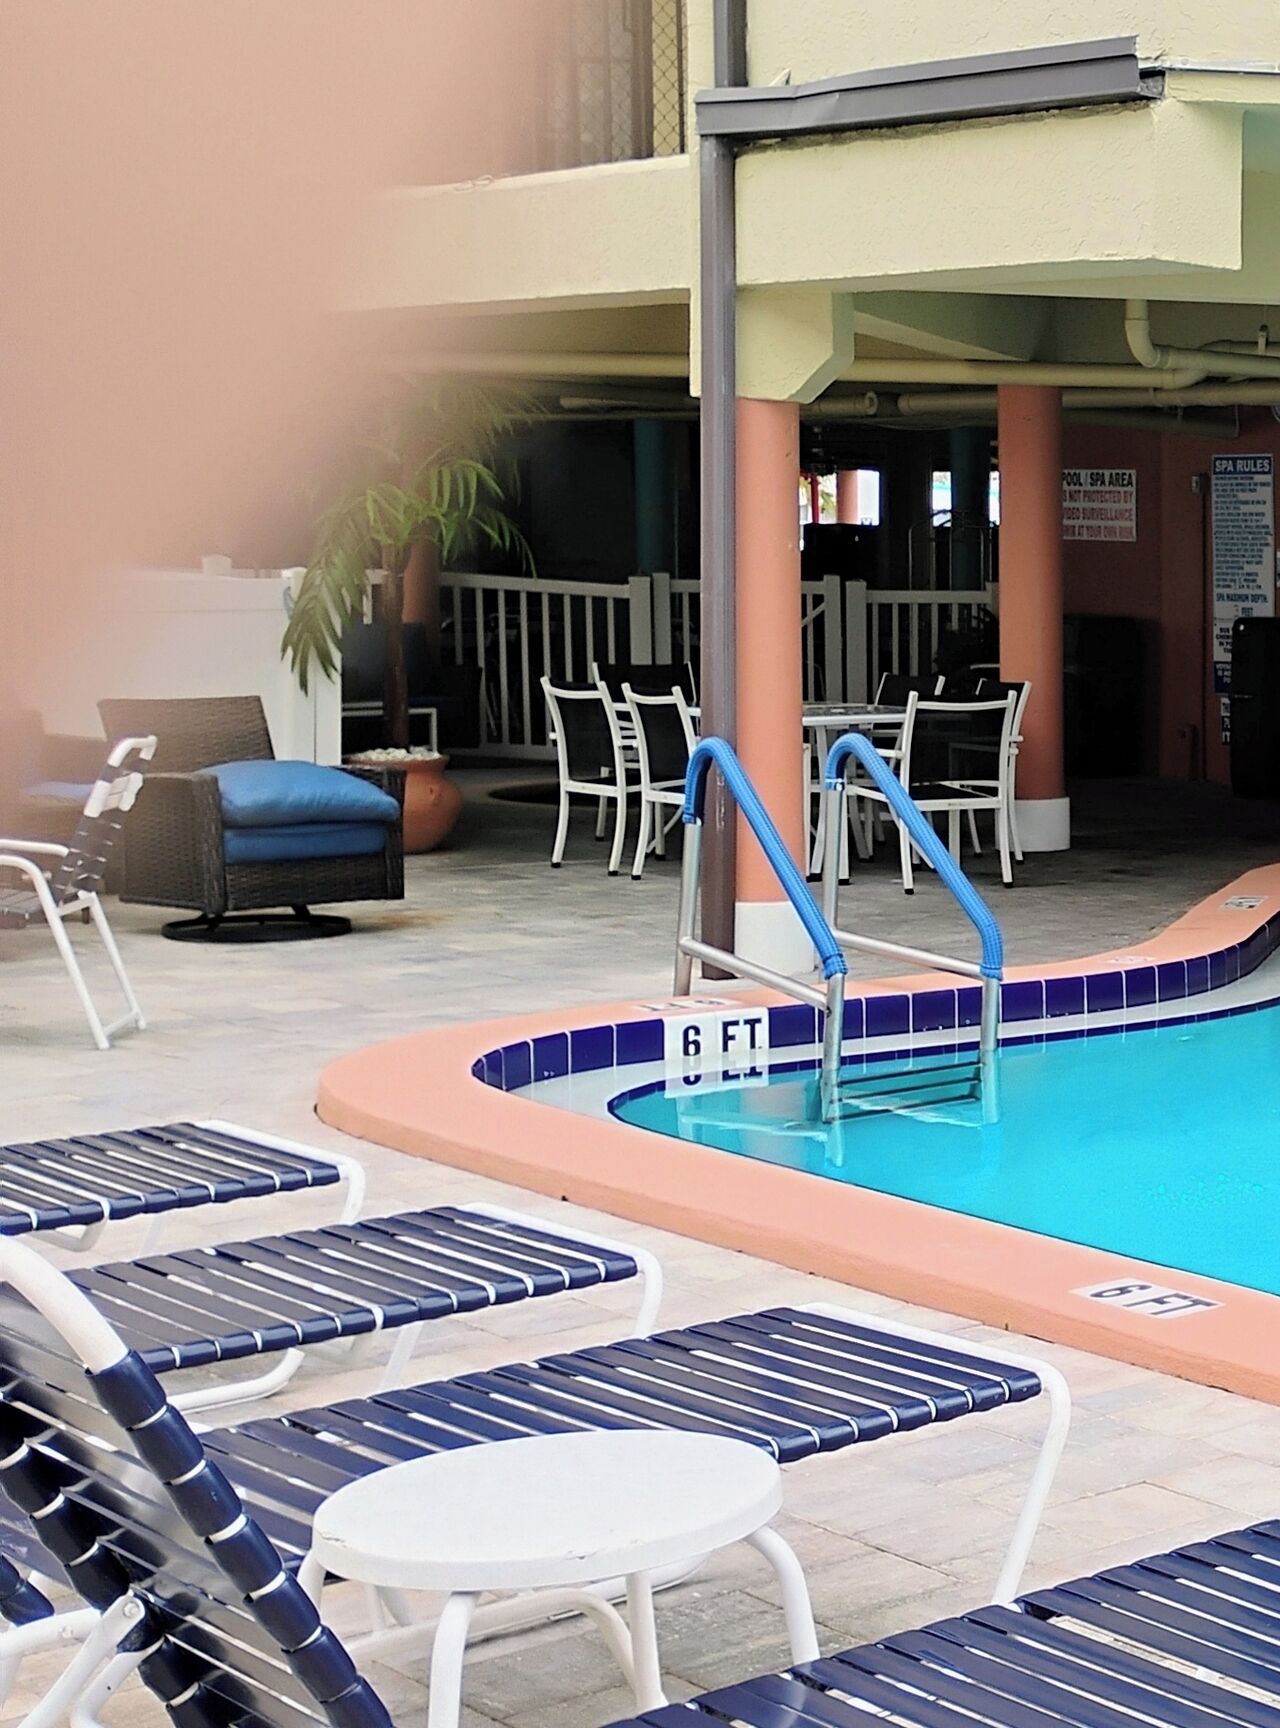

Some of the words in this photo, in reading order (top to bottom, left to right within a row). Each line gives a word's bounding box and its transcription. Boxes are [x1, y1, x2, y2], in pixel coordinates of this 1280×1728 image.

[1215, 460, 1234, 472] SPA
[1236, 459, 1270, 473] RULES
[1090, 472, 1106, 486] SPA
[1108, 472, 1133, 487] AREA
[683, 1025, 701, 1056] 6
[722, 1018, 762, 1052] FT
[1089, 1284, 1152, 1298] 6
[1122, 1293, 1219, 1315] FT
